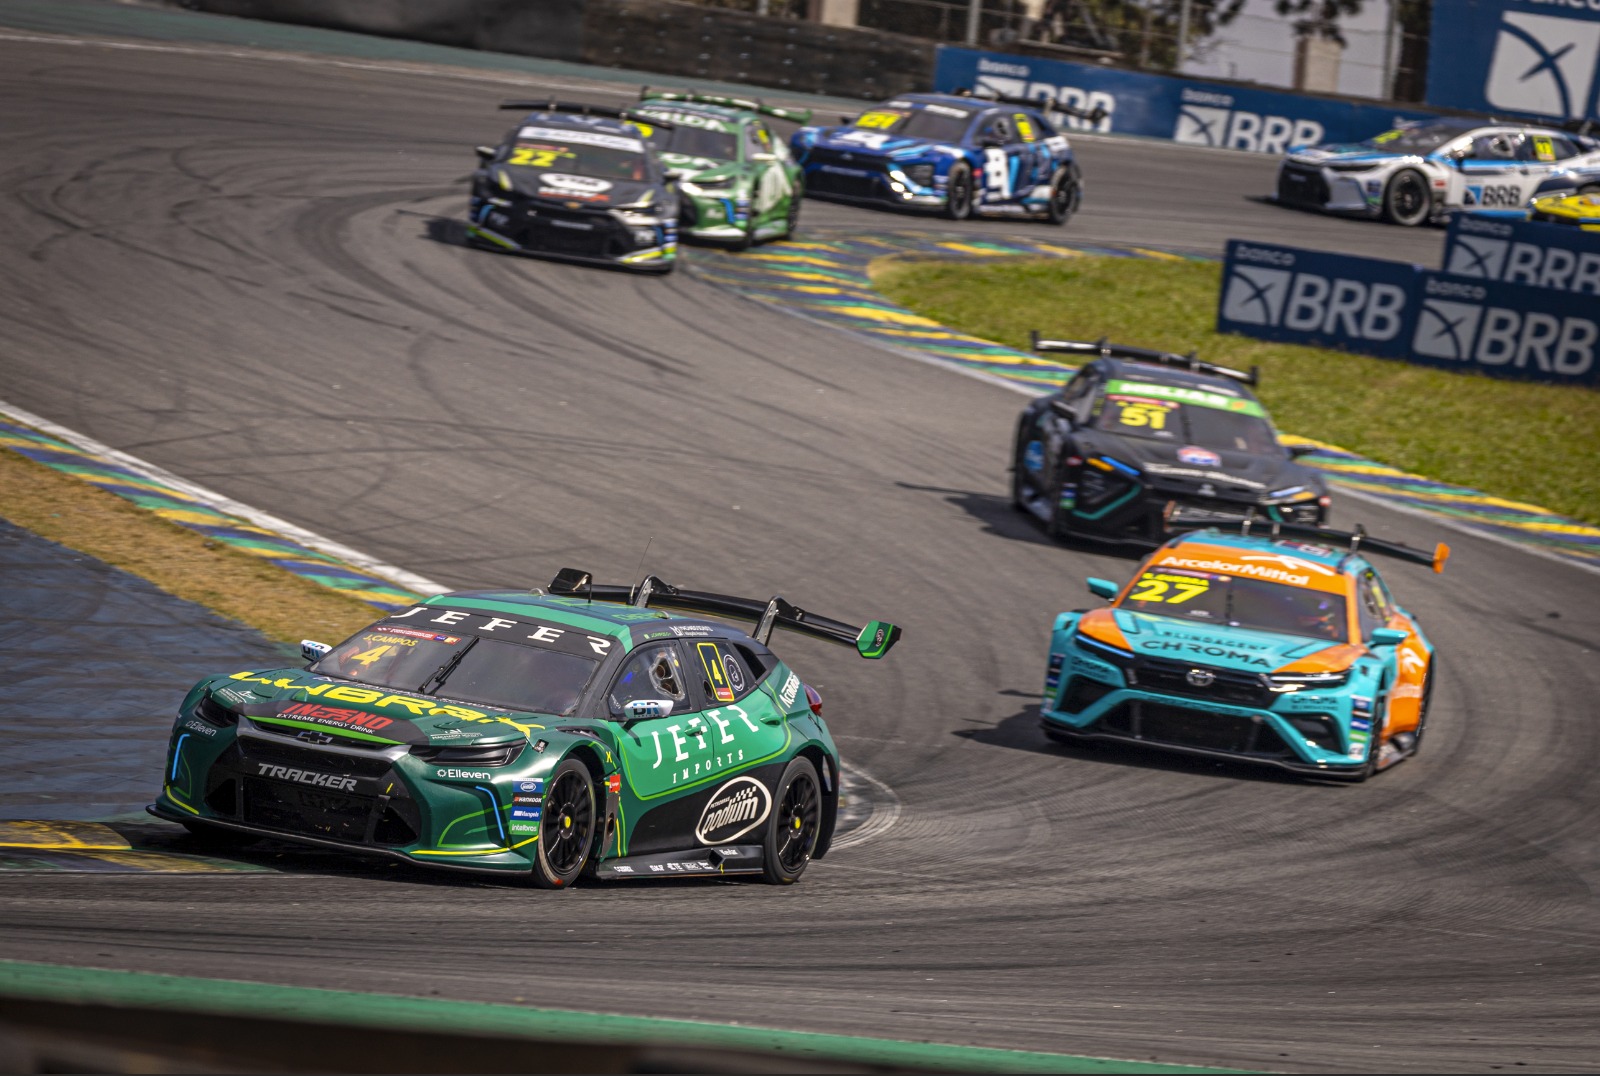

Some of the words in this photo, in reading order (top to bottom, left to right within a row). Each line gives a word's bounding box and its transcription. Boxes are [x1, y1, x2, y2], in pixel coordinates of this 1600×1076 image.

[1481, 185, 1521, 207] BRB
[1458, 215, 1513, 238] banco
[1235, 242, 1295, 266] banco
[1425, 277, 1487, 300] banco
[1284, 272, 1406, 341] BRB
[1476, 307, 1599, 376] BRB
[1119, 405, 1166, 429] 51
[1160, 556, 1310, 586] ArcelorMittal
[1129, 580, 1209, 604] 27
[391, 607, 612, 656] JEFER
[351, 645, 392, 666] 4
[1141, 640, 1271, 669] CHROMA
[711, 659, 723, 685] 4
[276, 713, 316, 723] EXTREME
[317, 719, 350, 728] ENERGY
[350, 724, 376, 735] DRINK
[651, 705, 759, 769] JEFER
[258, 763, 358, 791] TRACKER
[447, 769, 491, 780] Elleven
[673, 749, 743, 784] IMPORTS
[701, 797, 759, 839] podium
